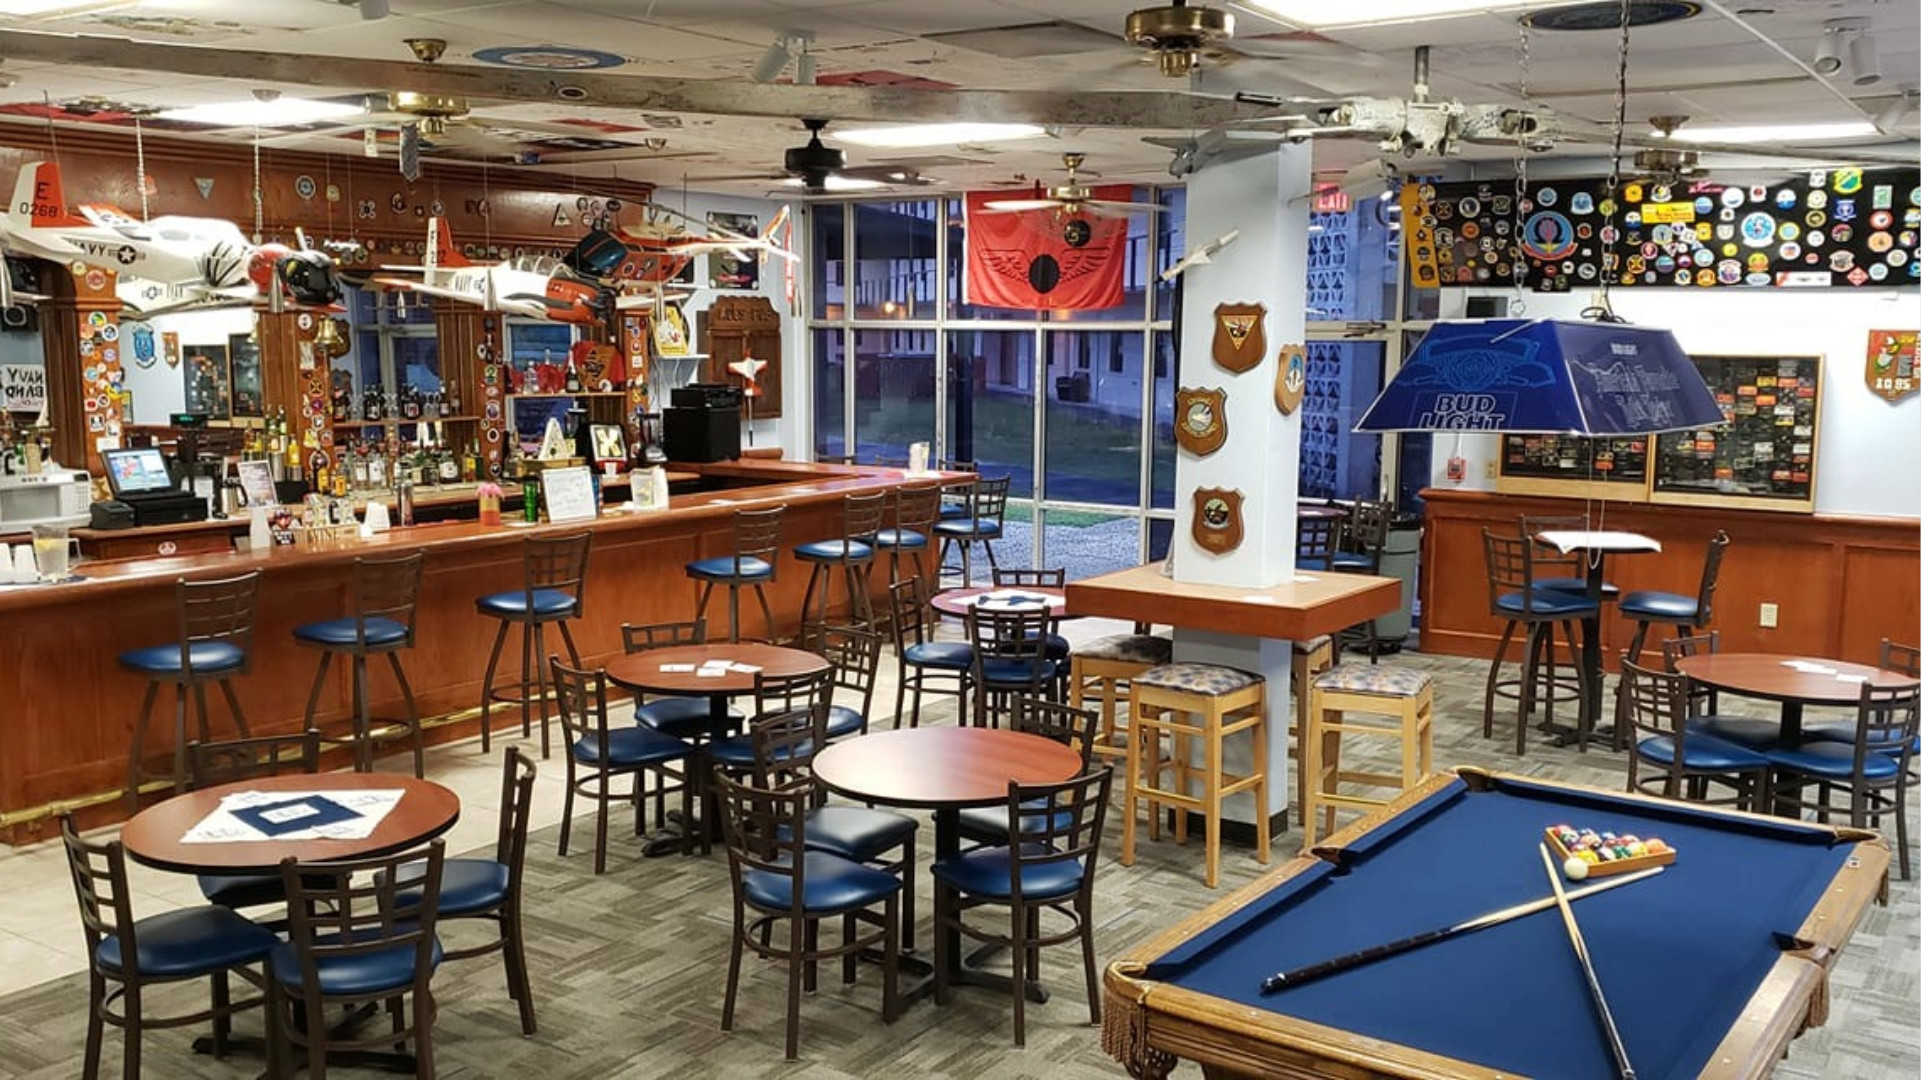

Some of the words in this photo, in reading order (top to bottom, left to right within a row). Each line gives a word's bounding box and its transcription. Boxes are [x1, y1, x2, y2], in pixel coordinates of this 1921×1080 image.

[37, 181, 50, 200] E
[19, 202, 58, 217] 0268
[1434, 394, 1496, 414] BUD
